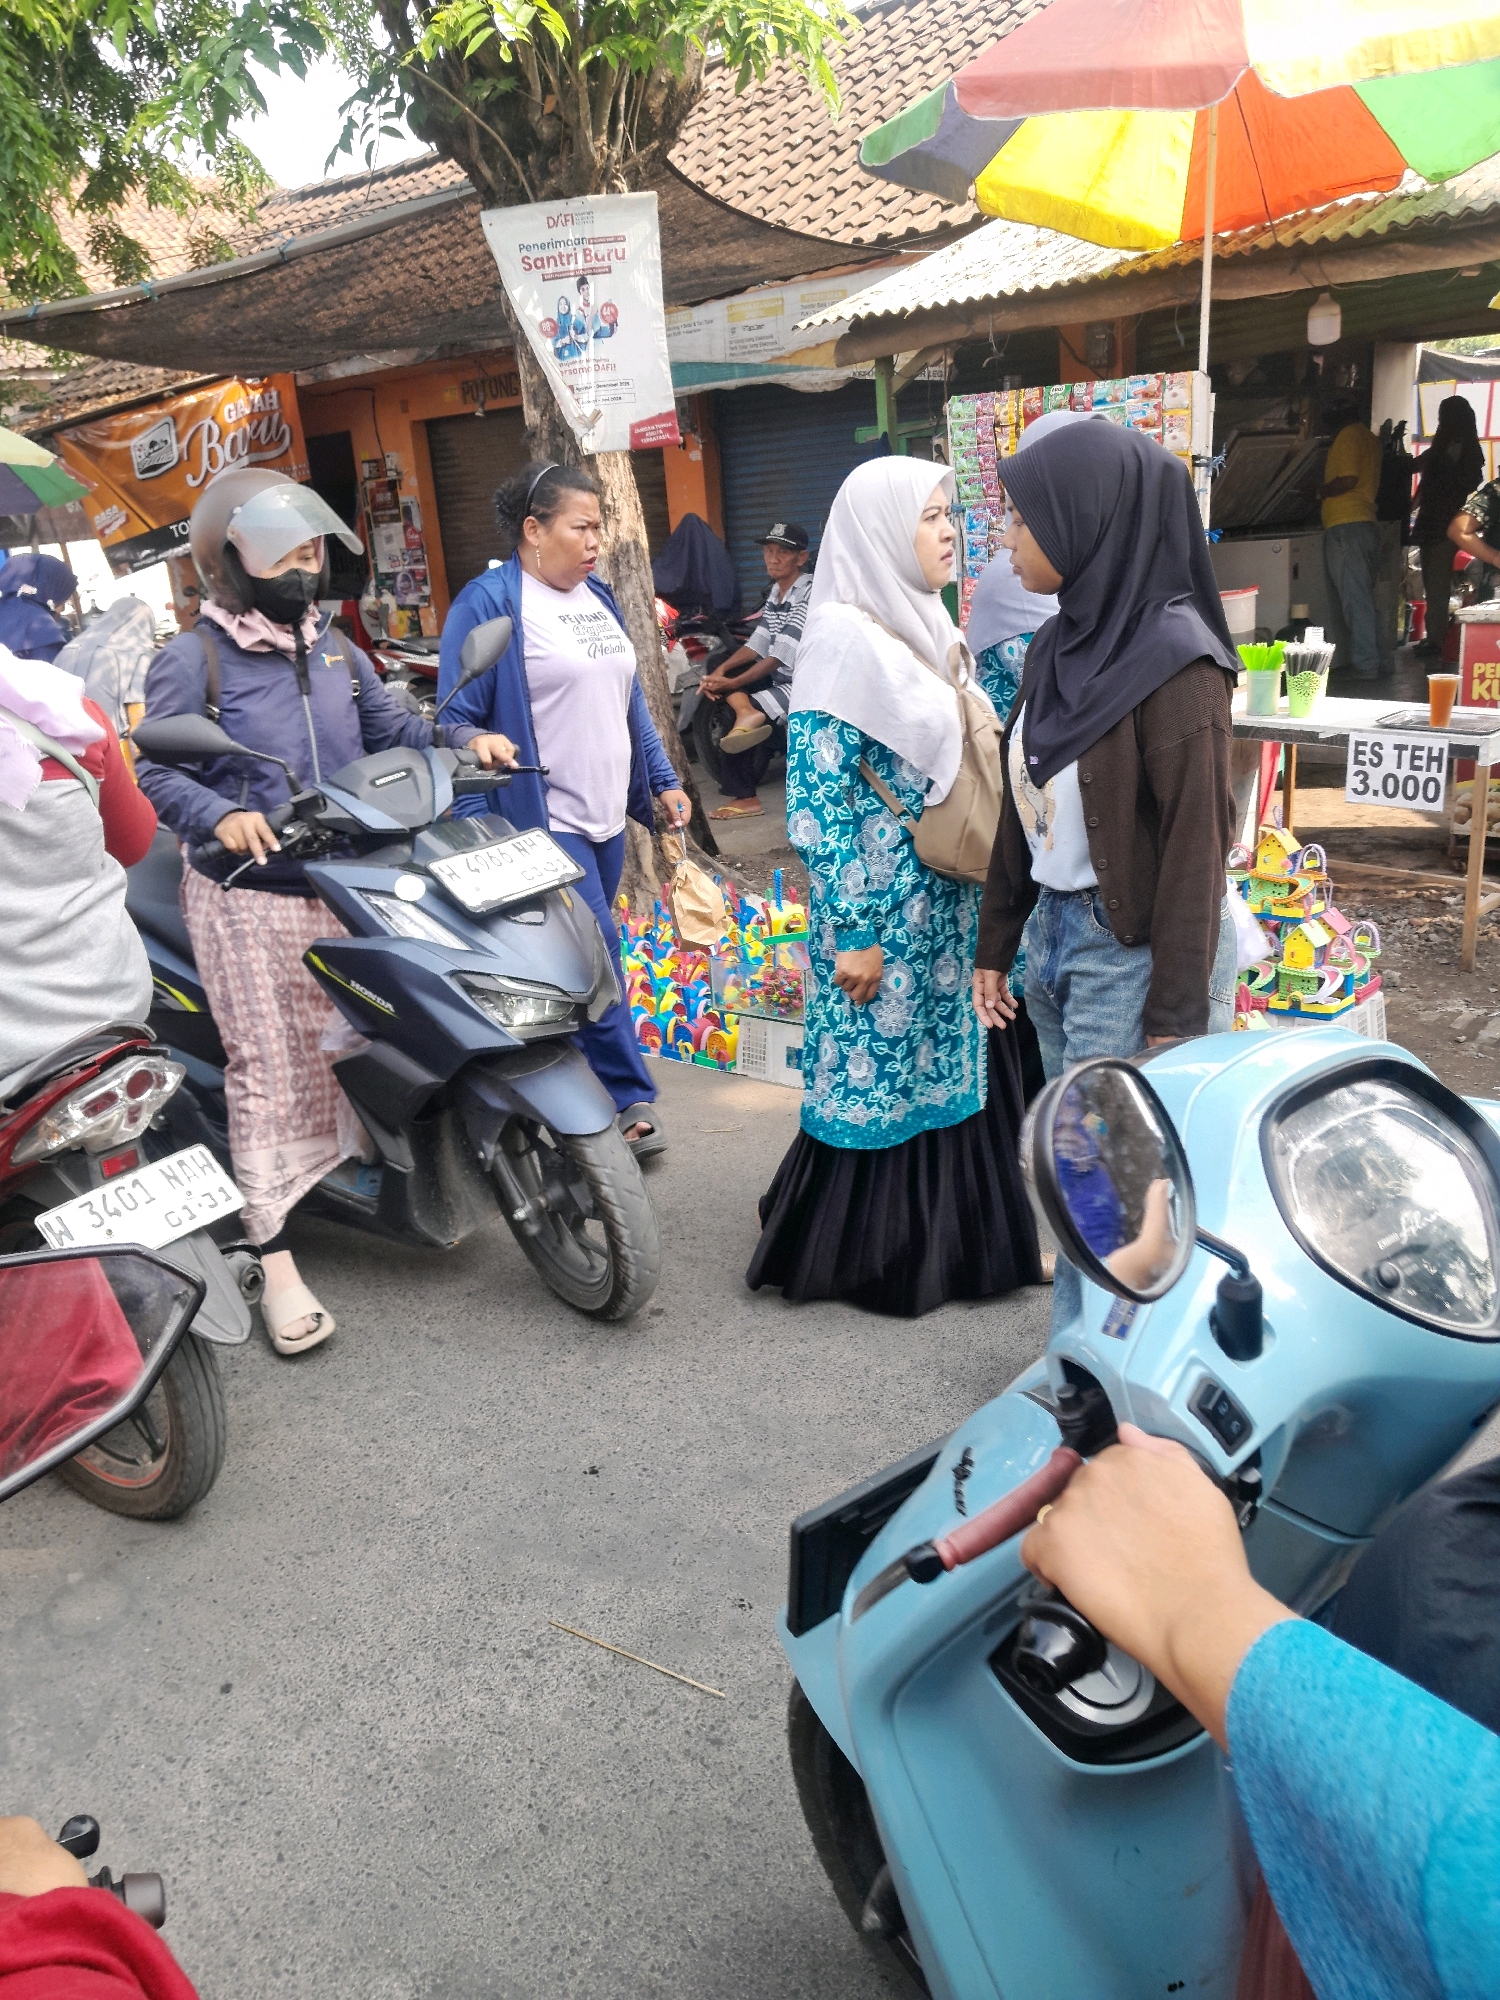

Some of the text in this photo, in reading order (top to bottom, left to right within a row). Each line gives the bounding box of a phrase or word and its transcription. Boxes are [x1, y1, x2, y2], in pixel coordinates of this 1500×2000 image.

[518, 236, 588, 253] Penerimaan
[521, 247, 626, 272] Santri Baru
[184, 412, 292, 488] Baru
[169, 518, 191, 539] TO
[558, 611, 608, 625] PEJUANG
[587, 641, 626, 659] Merah
[1353, 740, 1445, 773] ES TEH
[1351, 769, 1441, 804] 3.000
[350, 979, 396, 1013] HONDA
[44, 1150, 217, 1247] W 3401 NAW
